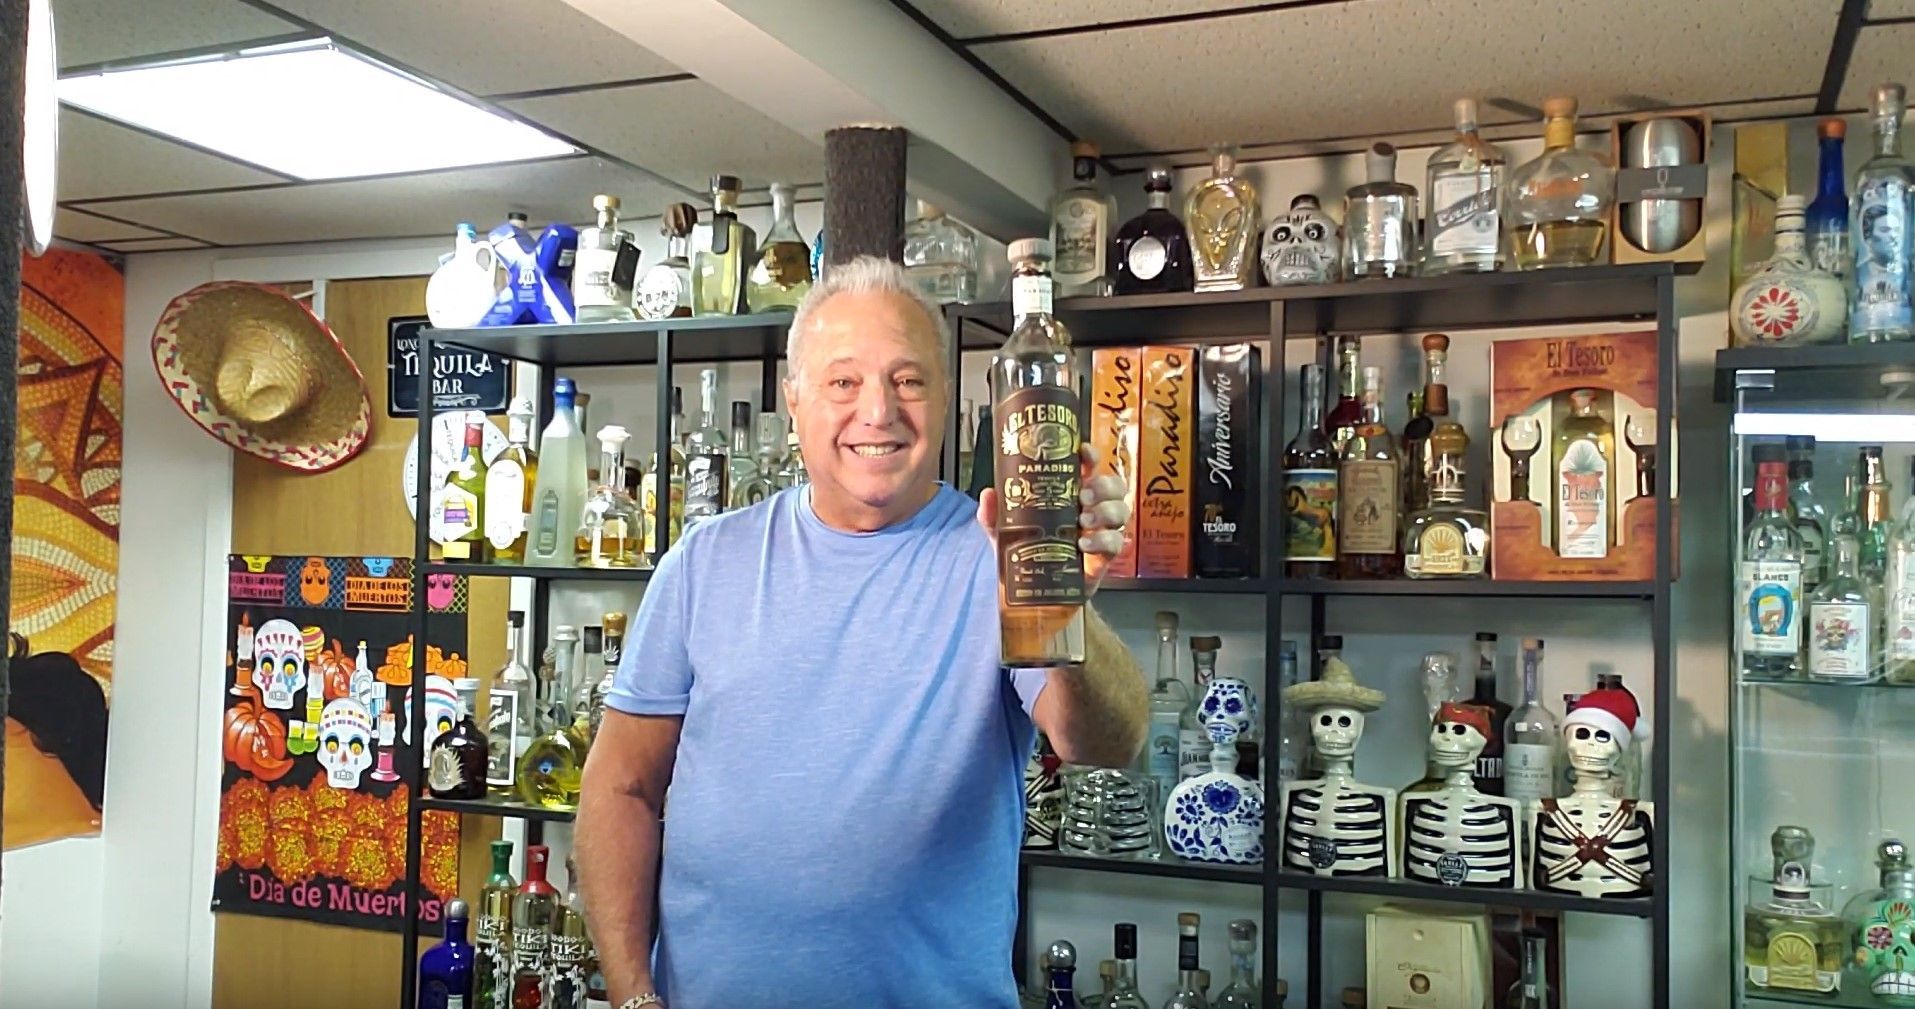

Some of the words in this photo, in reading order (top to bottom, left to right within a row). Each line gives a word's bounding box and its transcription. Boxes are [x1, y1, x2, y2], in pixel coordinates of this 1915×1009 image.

[1547, 342, 1561, 368] El
[1567, 341, 1614, 368] Tesoro
[432, 379, 463, 394] BAR
[1008, 411, 1026, 433] EL
[1025, 404, 1078, 434] TESORO
[1146, 353, 1184, 497] Paradiso
[1206, 372, 1233, 491] Aniversario
[1018, 464, 1075, 474] PARADISO
[1203, 522, 1236, 533] TESORO
[291, 880, 322, 908] de
[512, 933, 547, 944] TIKI
[551, 942, 585, 954] TIKI
